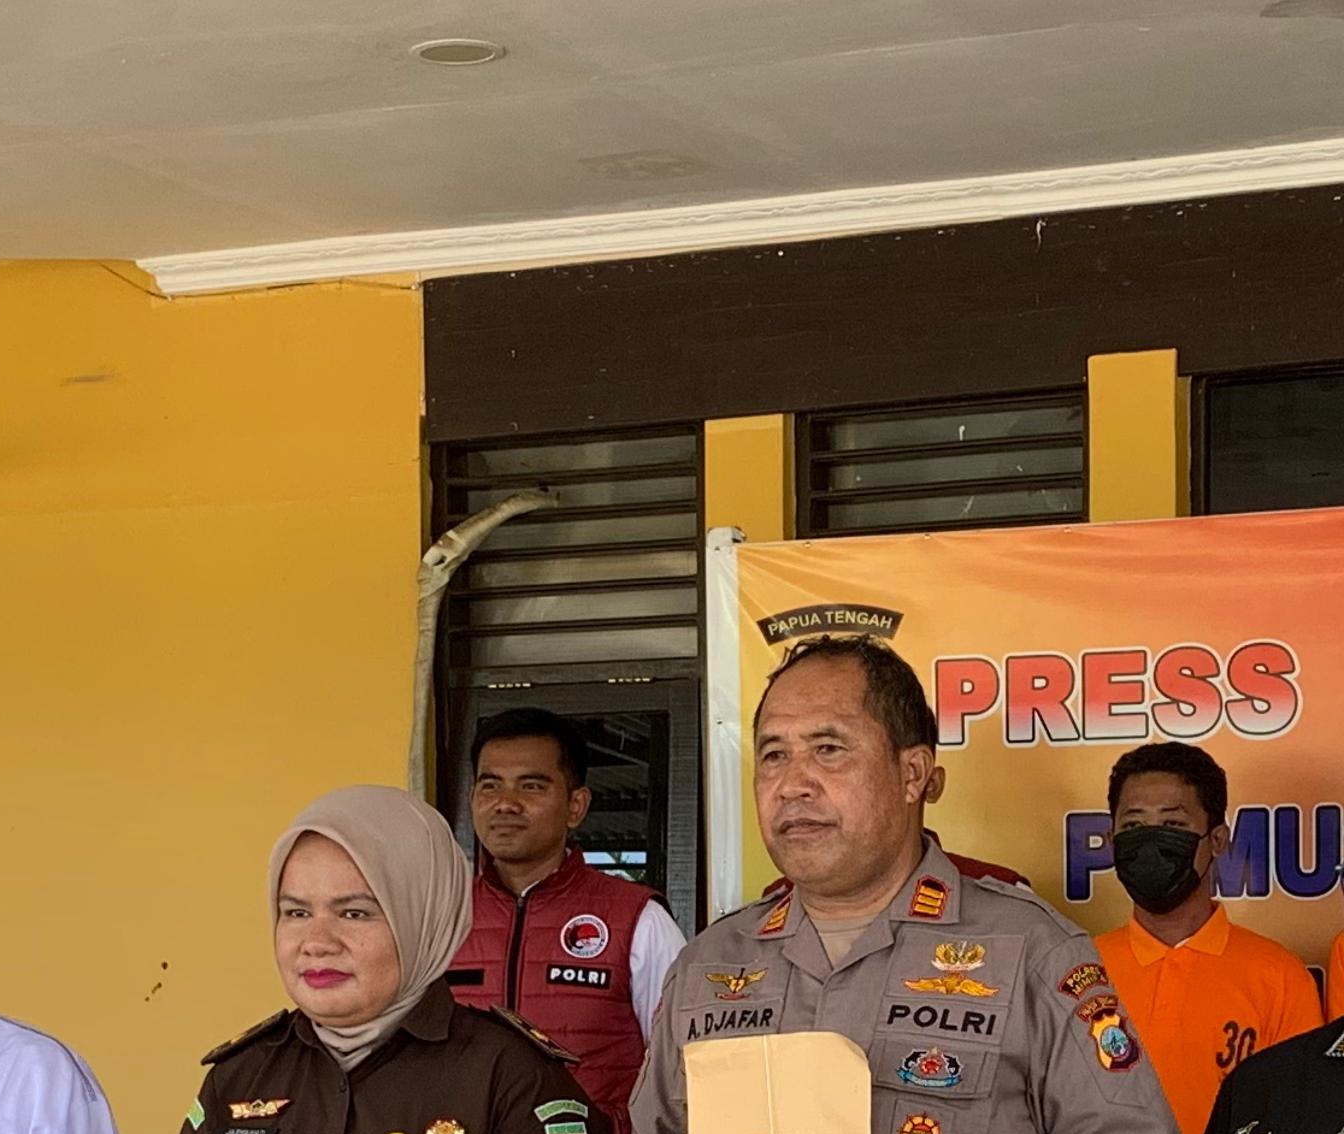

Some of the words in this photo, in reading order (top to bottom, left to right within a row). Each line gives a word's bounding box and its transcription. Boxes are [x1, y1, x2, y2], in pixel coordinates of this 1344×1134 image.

[767, 613, 821, 636] PAPUA
[825, 610, 893, 629] TENGAH
[933, 639, 1300, 748] PRESS
[550, 967, 606, 985] POLRI
[687, 1018, 701, 1040] A.
[704, 1008, 773, 1035] DJAFAR
[887, 1004, 996, 1036] POLRI
[1215, 1020, 1257, 1068] 30
